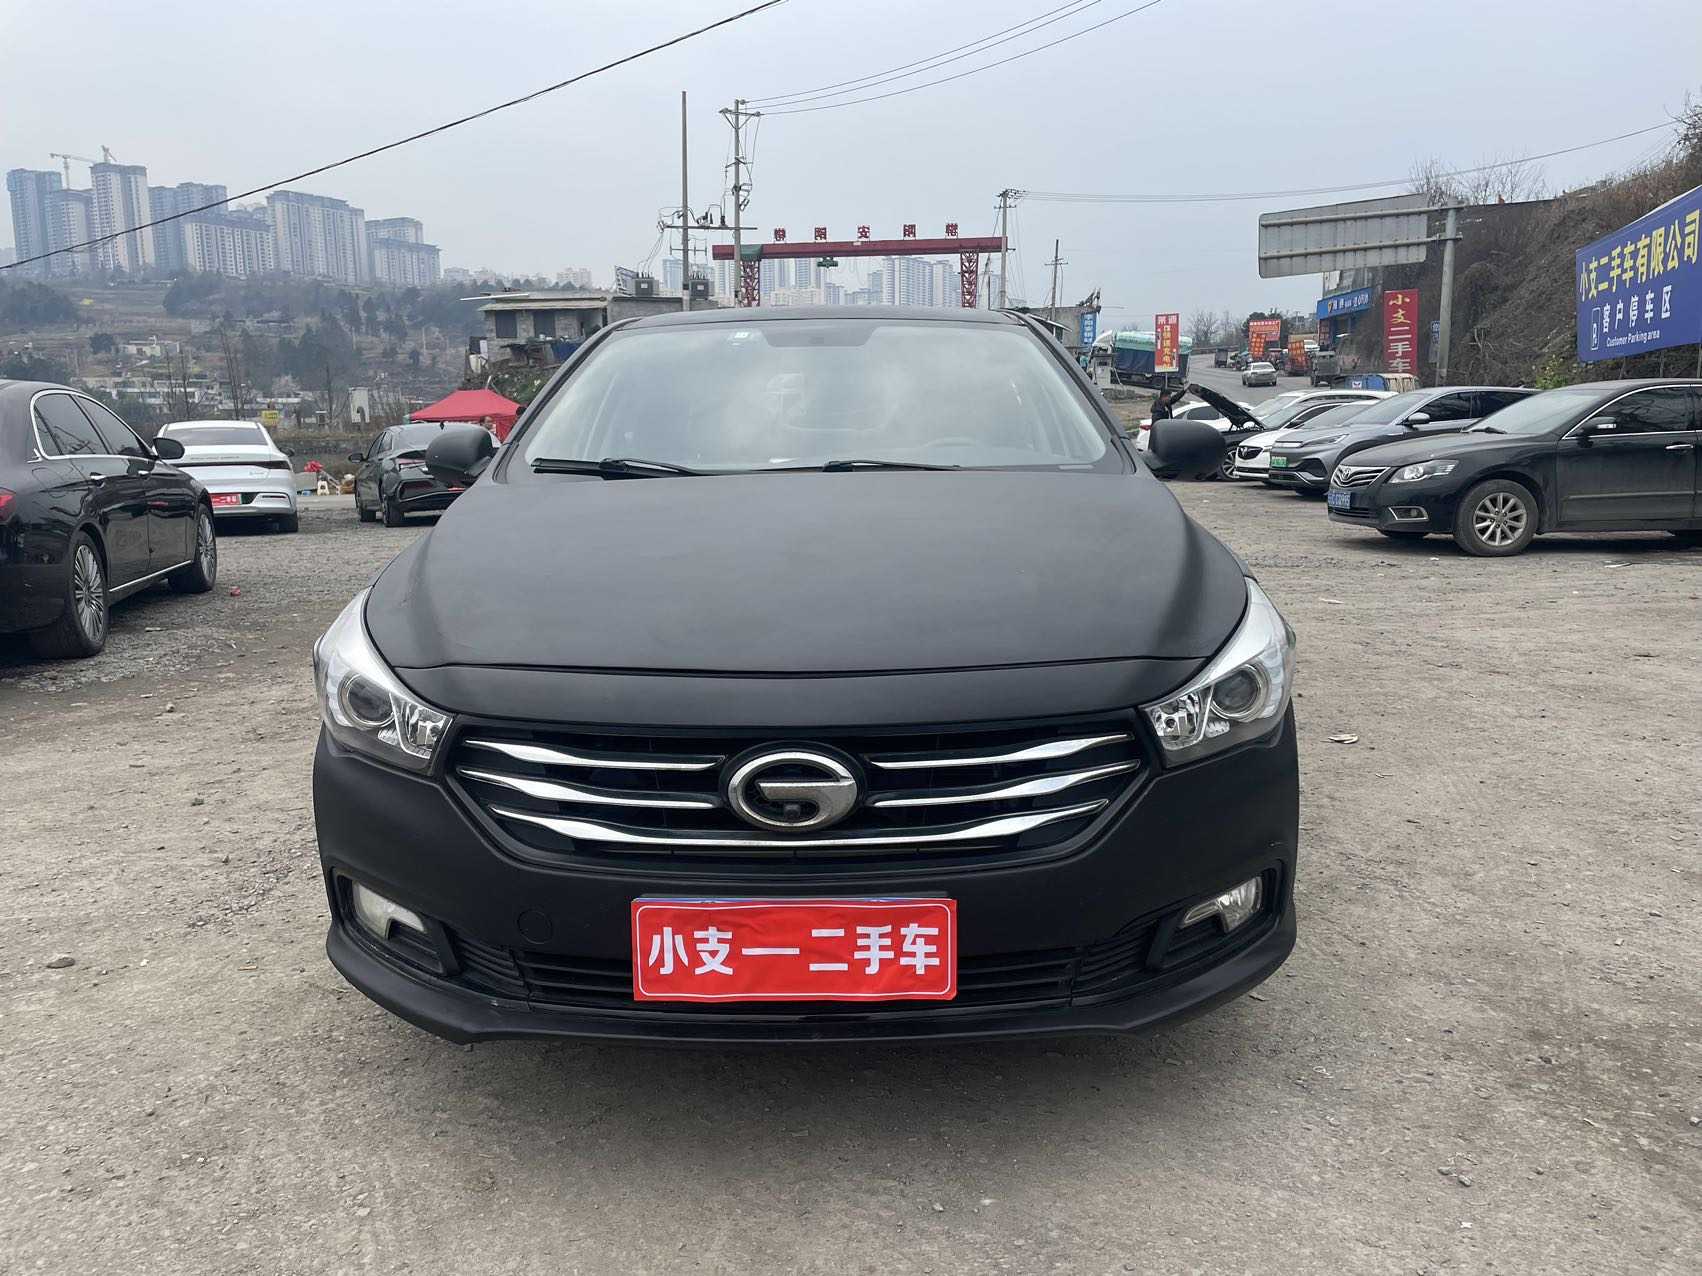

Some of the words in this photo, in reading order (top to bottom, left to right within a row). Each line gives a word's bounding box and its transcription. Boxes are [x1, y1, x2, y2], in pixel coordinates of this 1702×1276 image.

[1579, 208, 1700, 302] 小支二手车有限公司
[1602, 285, 1672, 333] 客户停车区
[1606, 335, 1628, 347] Customer
[1628, 331, 1648, 344] Parking
[1647, 329, 1660, 340] area
